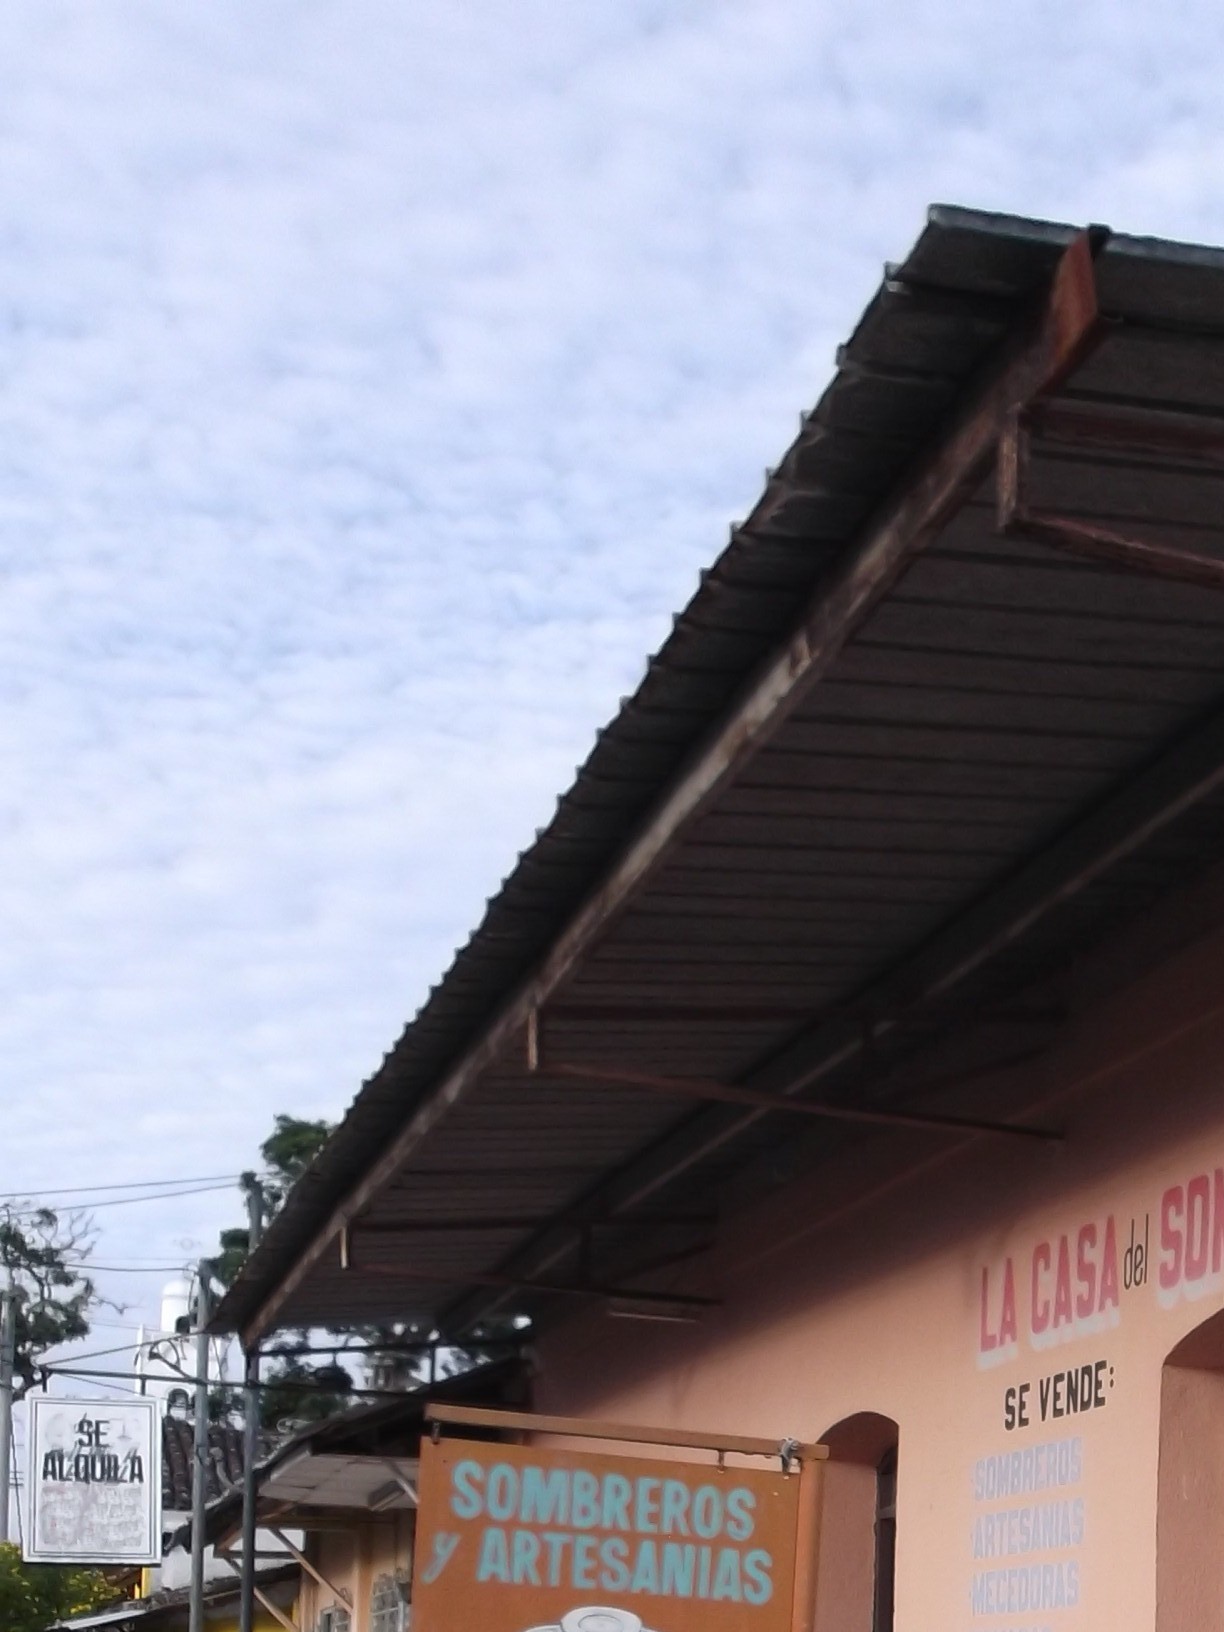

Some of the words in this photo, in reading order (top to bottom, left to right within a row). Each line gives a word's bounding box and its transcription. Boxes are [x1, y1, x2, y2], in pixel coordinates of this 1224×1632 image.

[979, 1257, 1018, 1353] LA
[1030, 1215, 1120, 1334] CASA
[1123, 1213, 1150, 1292] del
[1004, 1383, 1031, 1431] SE
[1039, 1360, 1114, 1422] VENDE:
[42, 1450, 144, 1484] ALQUILA
[77, 1419, 111, 1448] SE
[450, 1459, 757, 1542] SOMBREROS
[973, 1436, 1083, 1503] SOMBREROS
[972, 1498, 1085, 1560] ARTESANIAS
[477, 1527, 775, 1606] ARTESANIAS
[970, 1561, 1080, 1616] MECEDORAS
